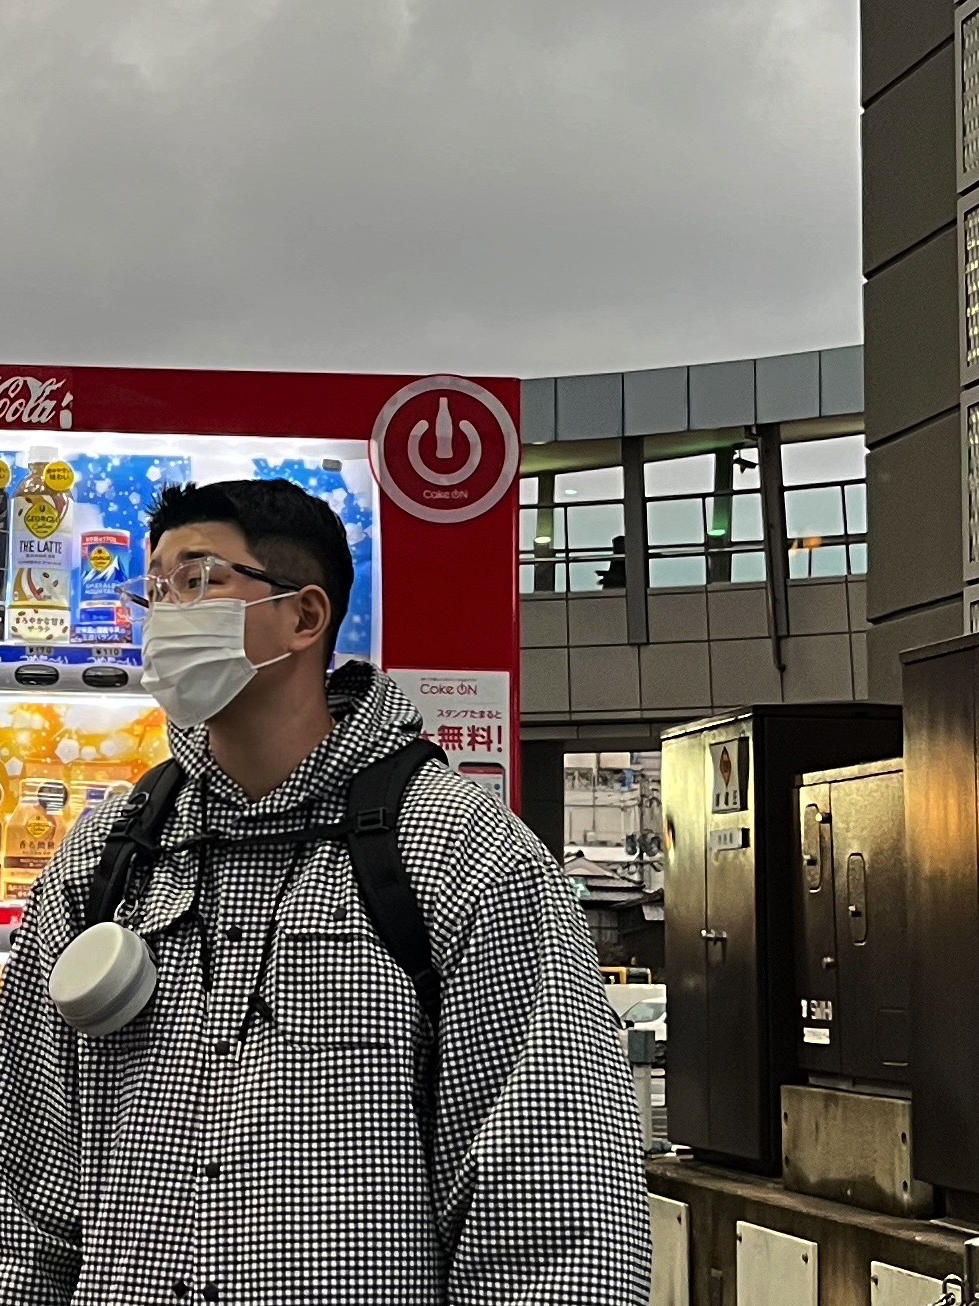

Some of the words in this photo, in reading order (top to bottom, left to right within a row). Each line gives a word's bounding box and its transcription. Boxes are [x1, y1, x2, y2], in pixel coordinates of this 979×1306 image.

[423, 489, 450, 500] Coke
[20, 540, 35, 553] THE
[37, 541, 63, 555] LATTE
[420, 683, 455, 695] Coke
[456, 682, 478, 696] ON
[436, 708, 503, 720] スタンプたまると
